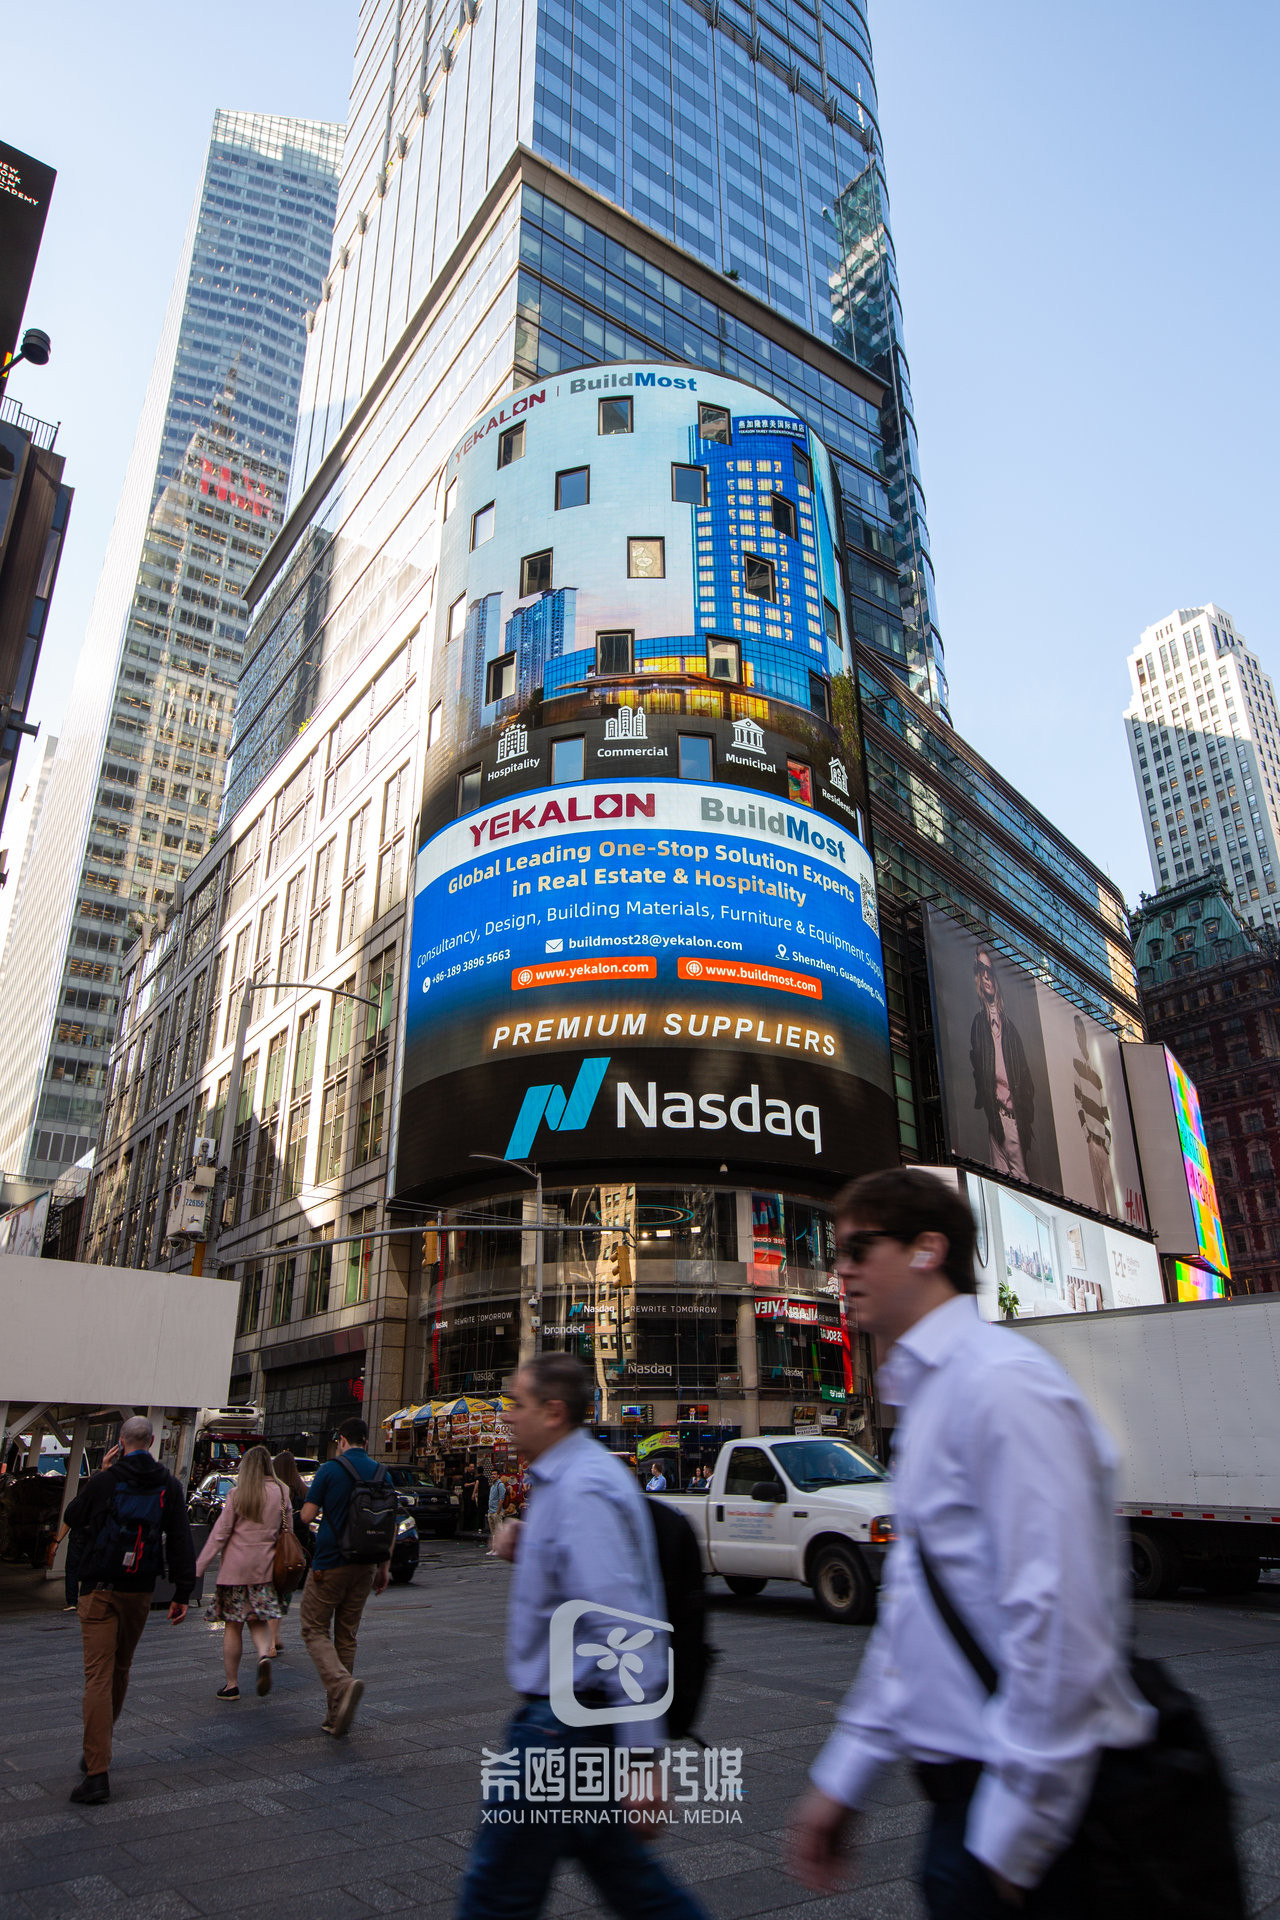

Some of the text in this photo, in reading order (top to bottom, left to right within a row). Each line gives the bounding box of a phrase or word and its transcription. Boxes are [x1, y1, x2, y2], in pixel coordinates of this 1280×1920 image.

[455, 372, 697, 465] YEKALON BuildMost
[597, 746, 668, 758] Commercial
[725, 753, 777, 774] Municipal
[487, 756, 540, 781] Hospitality
[822, 788, 856, 819] Residential
[469, 793, 846, 863] YEKALON BuildMost
[448, 840, 855, 903] Global Leading One-Stop Solution Experts
[512, 866, 806, 907] in Real Estate & Hospitality
[417, 928, 481, 969] Consultancy,
[485, 913, 541, 936] Design,
[547, 901, 619, 922] Building
[626, 901, 715, 920] Materials,
[721, 905, 792, 931] Furniture
[796, 920, 806, 935] &
[809, 924, 864, 962] Equipment
[568, 933, 743, 951] buildmost28@yekalon.com
[432, 948, 511, 984] +86-189 3896 5663
[535, 962, 649, 980] www.yekalon.com
[792, 951, 839, 977] Shenzhen,
[706, 965, 817, 993] www.buildmost.com
[492, 1013, 836, 1056] PREMIUM SUPPLIERS
[616, 1081, 823, 1155] Nasdaq
[1125, 1187, 1145, 1229] H&M
[477, 1311, 513, 1322] TOMORROW
[583, 1304, 615, 1314] Nasdaq
[630, 1305, 718, 1314] REWRITE TOMORROW
[628, 1362, 672, 1376] Nasdaq
